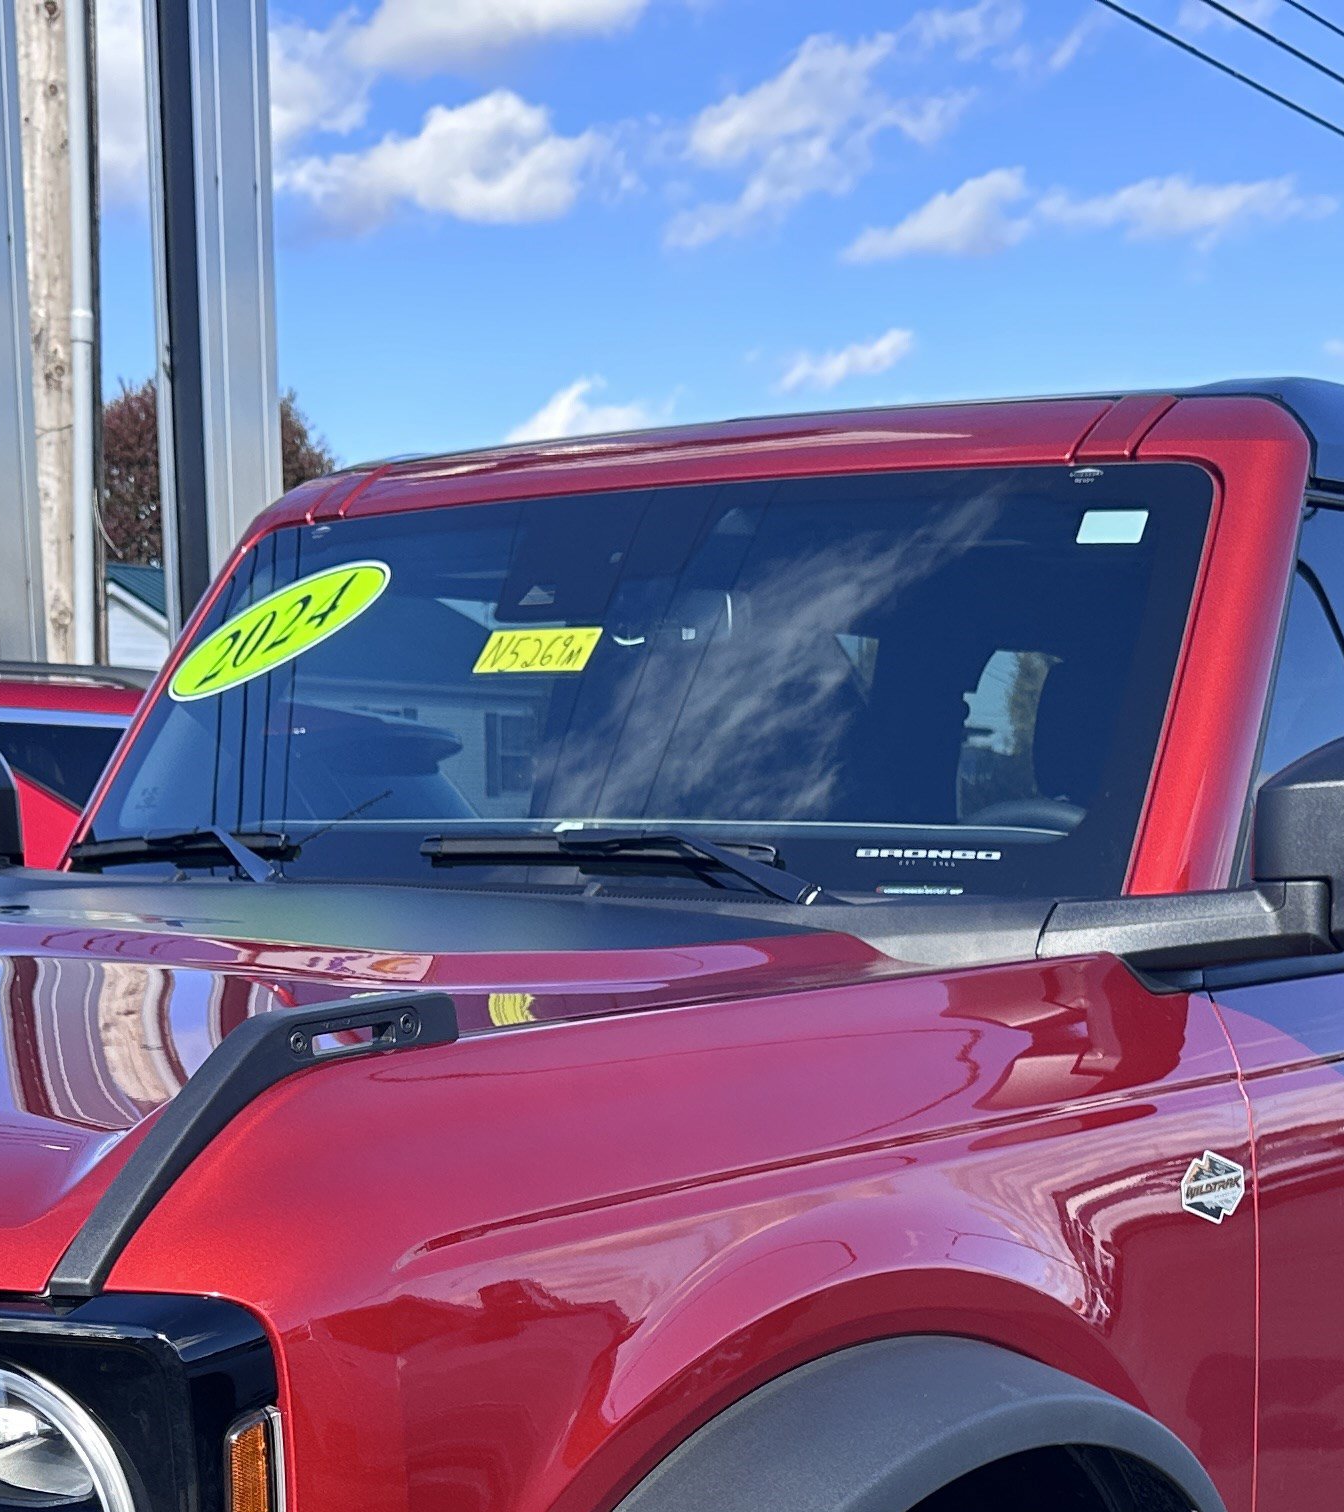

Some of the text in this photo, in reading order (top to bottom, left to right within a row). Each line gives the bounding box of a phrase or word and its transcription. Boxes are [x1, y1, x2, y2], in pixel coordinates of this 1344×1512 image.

[195, 571, 360, 690] 2024
[856, 848, 1002, 861] BRONCO
[1185, 1174, 1242, 1200] WILDTRAK
